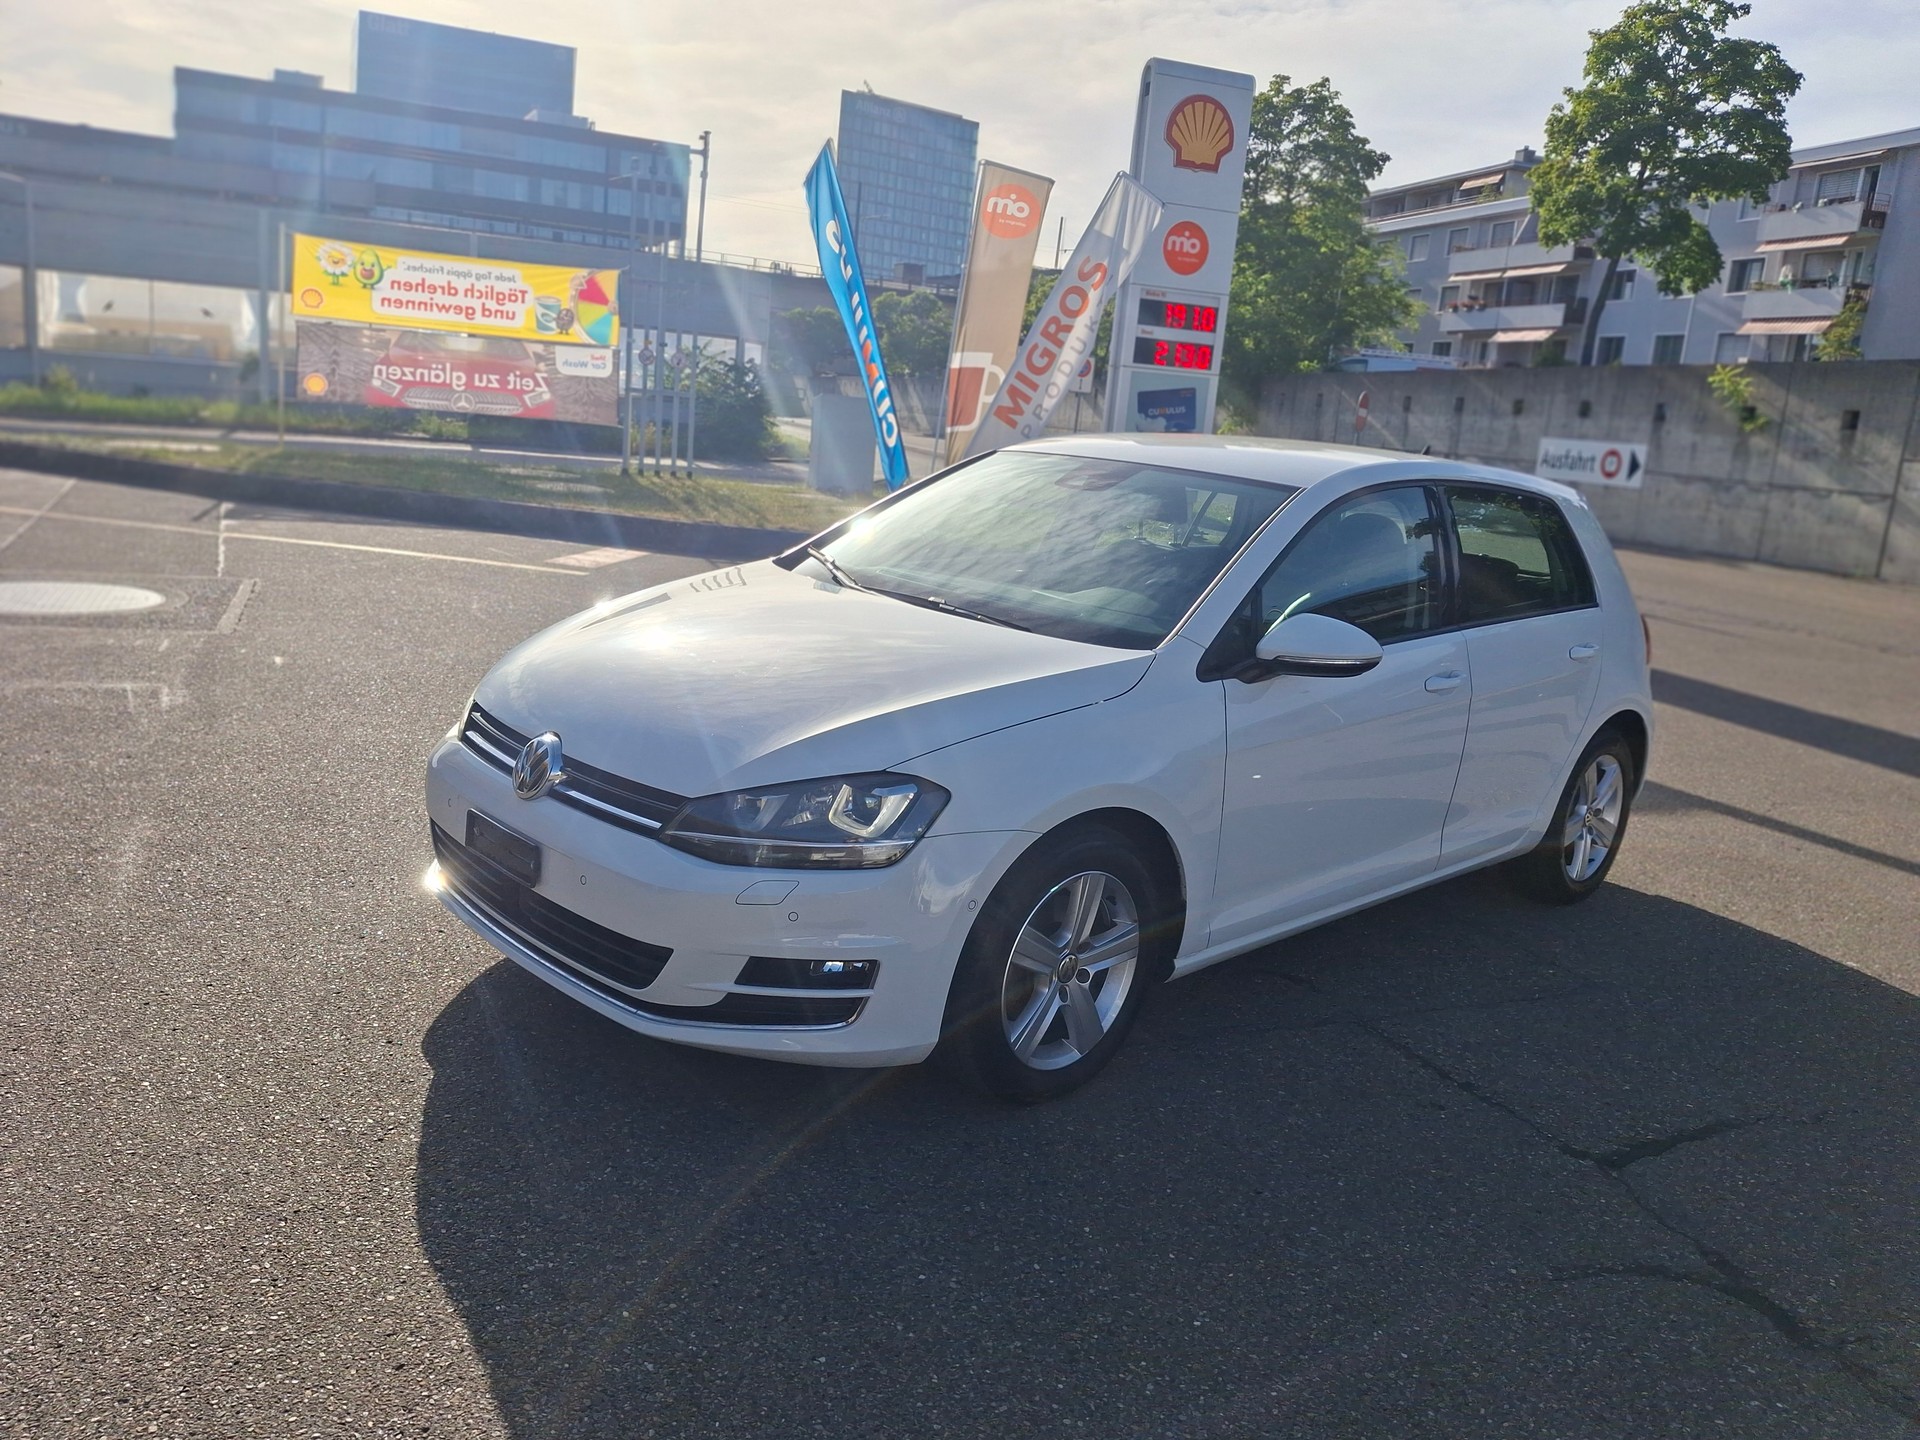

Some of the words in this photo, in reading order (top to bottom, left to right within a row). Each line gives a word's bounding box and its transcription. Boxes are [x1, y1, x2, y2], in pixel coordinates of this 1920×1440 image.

[986, 193, 1030, 218] mio
[1167, 231, 1200, 254] mio
[992, 255, 1108, 430] MIGROS
[1540, 449, 1597, 473] Ausfahrt
